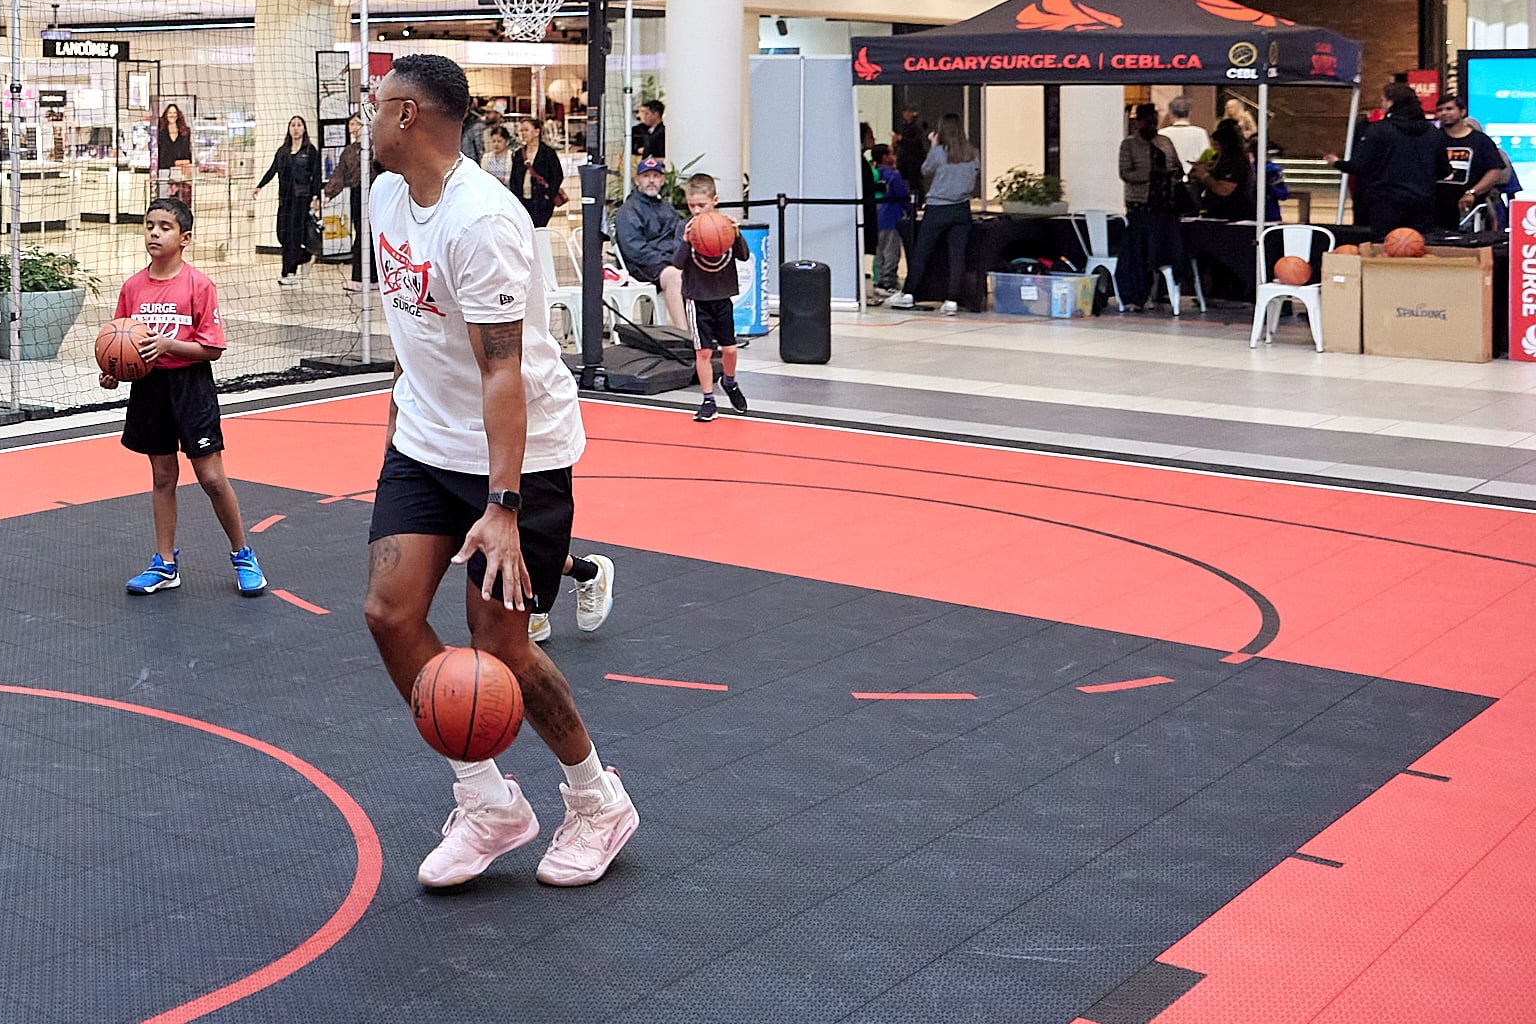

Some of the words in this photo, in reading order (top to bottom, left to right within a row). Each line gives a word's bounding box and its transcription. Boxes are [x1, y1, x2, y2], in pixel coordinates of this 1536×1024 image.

[903, 54, 1091, 71] CALGARYSURGE.CA
[1110, 53, 1202, 69] CEBL.CA
[1226, 67, 1259, 79] CEBL
[139, 303, 177, 314] SURGE
[392, 297, 422, 318] SURGE
[1395, 304, 1447, 320] SPALDING
